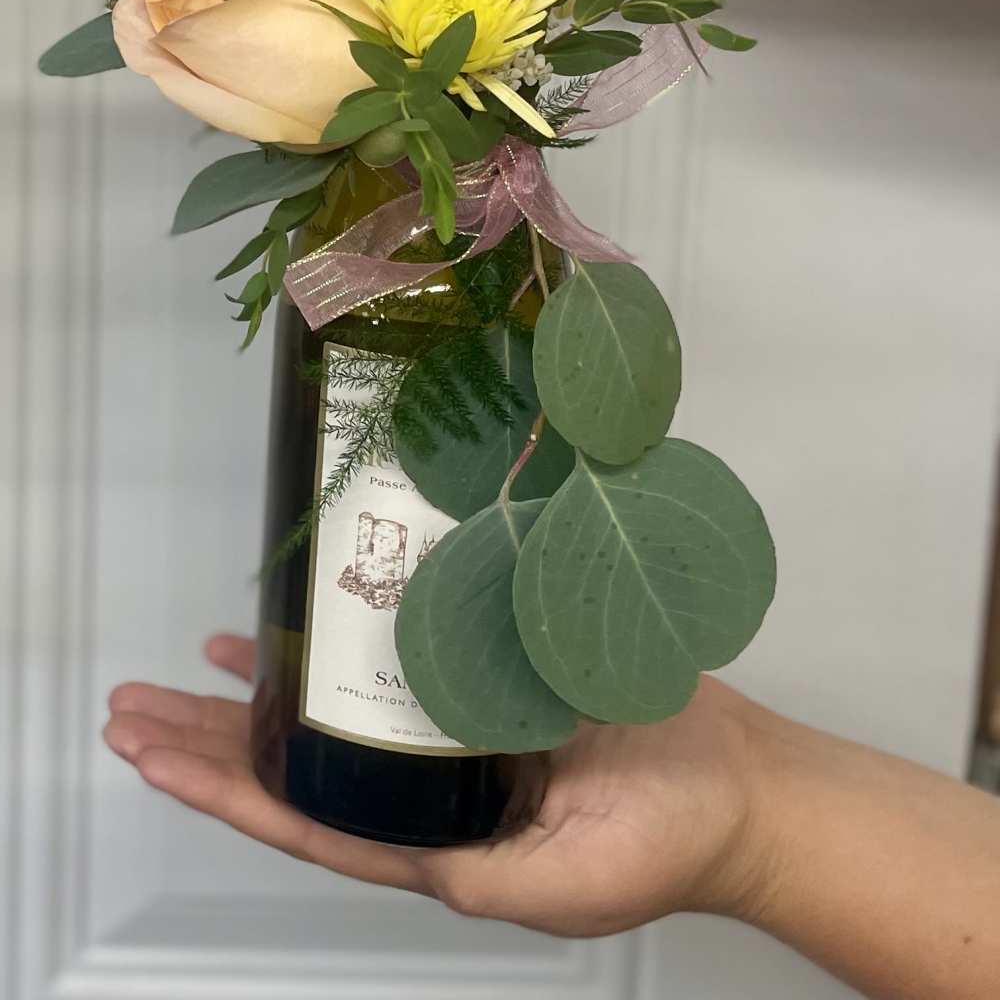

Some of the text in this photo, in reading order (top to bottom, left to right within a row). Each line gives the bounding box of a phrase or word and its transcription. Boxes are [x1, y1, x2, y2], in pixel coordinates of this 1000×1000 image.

[369, 476, 408, 491] Passe
[336, 684, 406, 707] APPELLATION
[390, 726, 402, 735] Val
[403, 728, 412, 736] de
